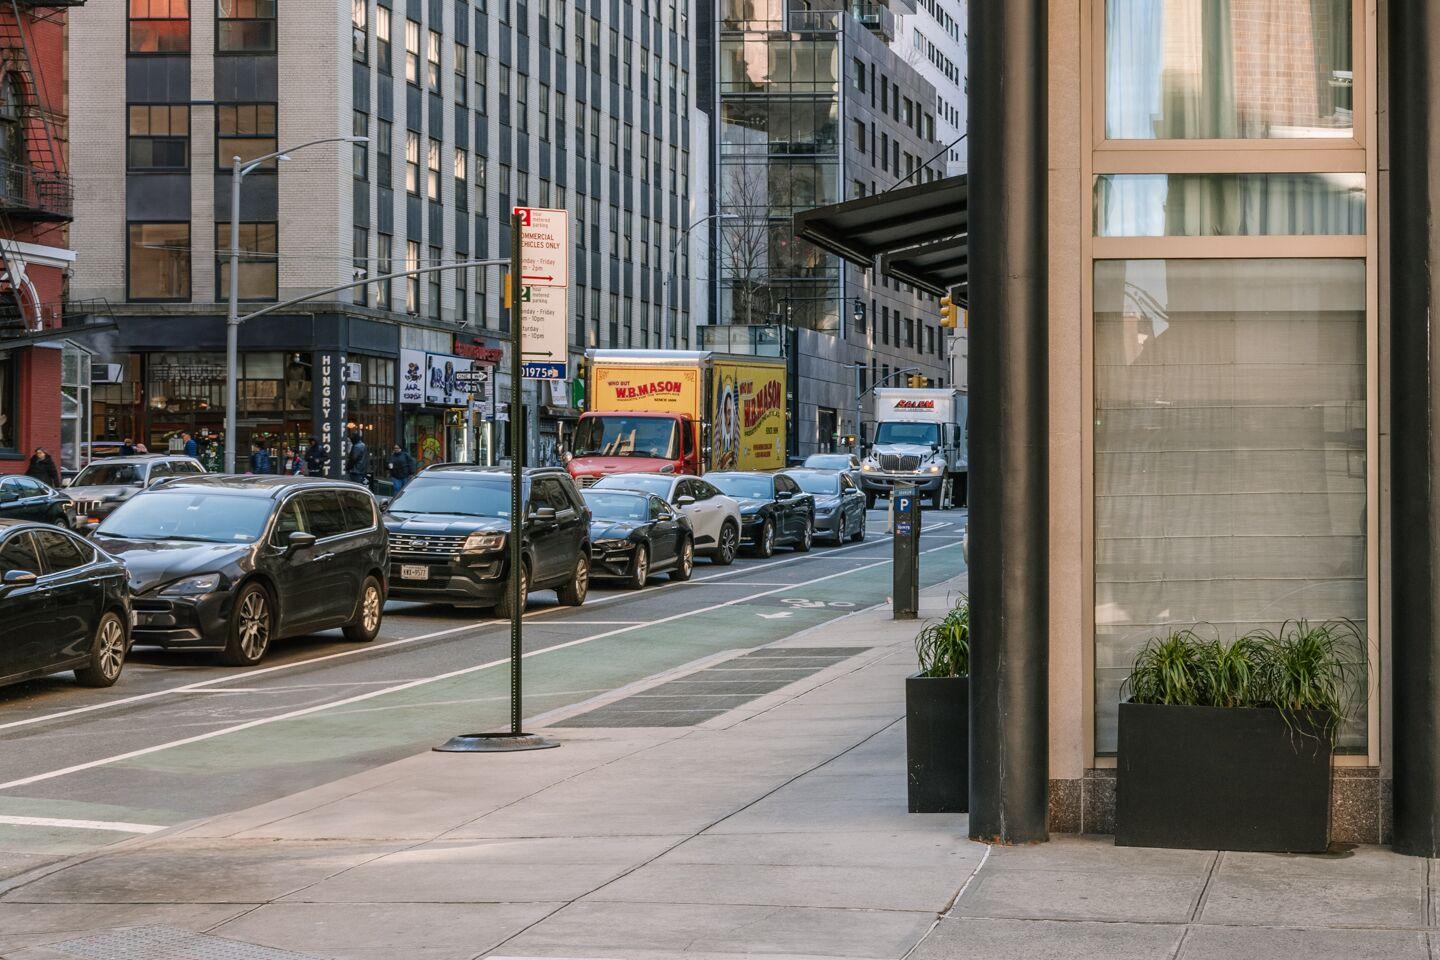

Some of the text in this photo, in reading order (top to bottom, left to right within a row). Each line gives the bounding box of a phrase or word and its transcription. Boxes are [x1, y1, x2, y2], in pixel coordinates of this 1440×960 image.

[521, 232, 554, 241] OMMERCIAL
[521, 241, 560, 250] EHICLES ONLY
[540, 258, 555, 266] Friday
[540, 308, 555, 316] Friday
[322, 356, 331, 419] HUNGRY
[616, 381, 682, 399] W.B.MASON
[900, 498, 909, 511] P
